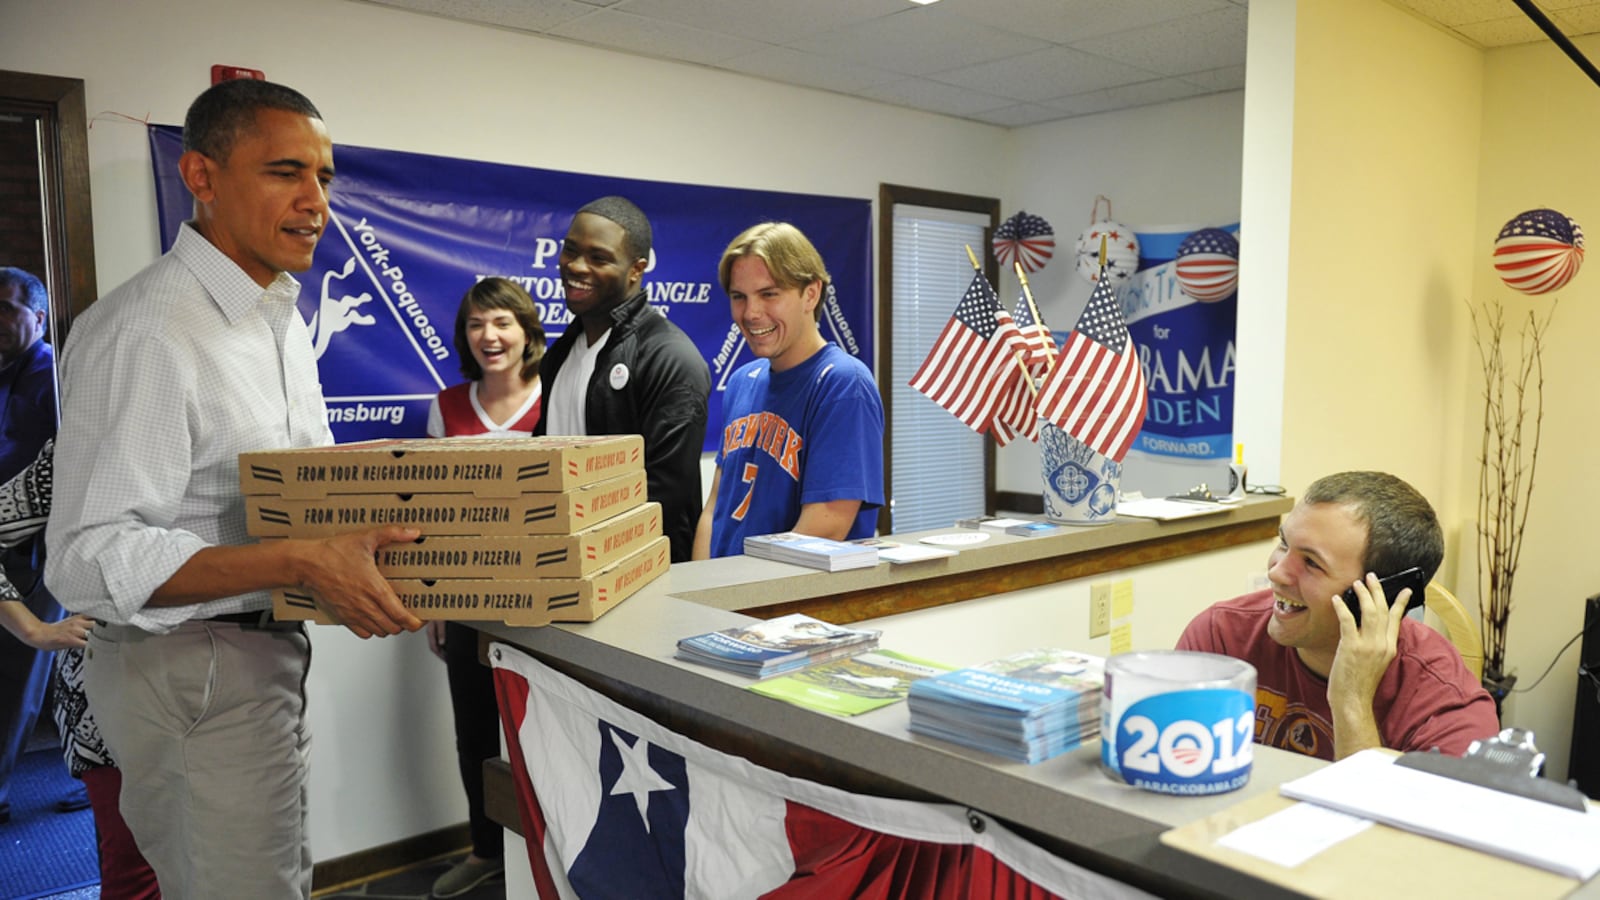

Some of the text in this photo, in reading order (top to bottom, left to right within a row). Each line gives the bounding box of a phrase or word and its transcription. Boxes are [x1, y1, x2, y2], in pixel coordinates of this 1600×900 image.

[353, 217, 449, 361] York-Poquoson
[646, 281, 712, 303] ANGLE
[827, 284, 860, 355] Poquoson
[1153, 325, 1170, 339] for
[713, 322, 741, 374] James
[1139, 340, 1236, 394] BAMA
[327, 403, 405, 425] msburg
[1145, 395, 1220, 425] DEN
[297, 464, 503, 482] FROM YOUR NEIGHBORHOOD PIZZERIA
[731, 462, 759, 521] 7
[304, 506, 510, 524] FROM YOUR NEIGHBORHOOD PIZZERIA
[384, 550, 468, 566] NEIGHBORHOOD
[472, 550, 521, 566] PIZZERIA
[483, 593, 533, 609] PIZZERIA
[1122, 709, 1255, 777] 2012
